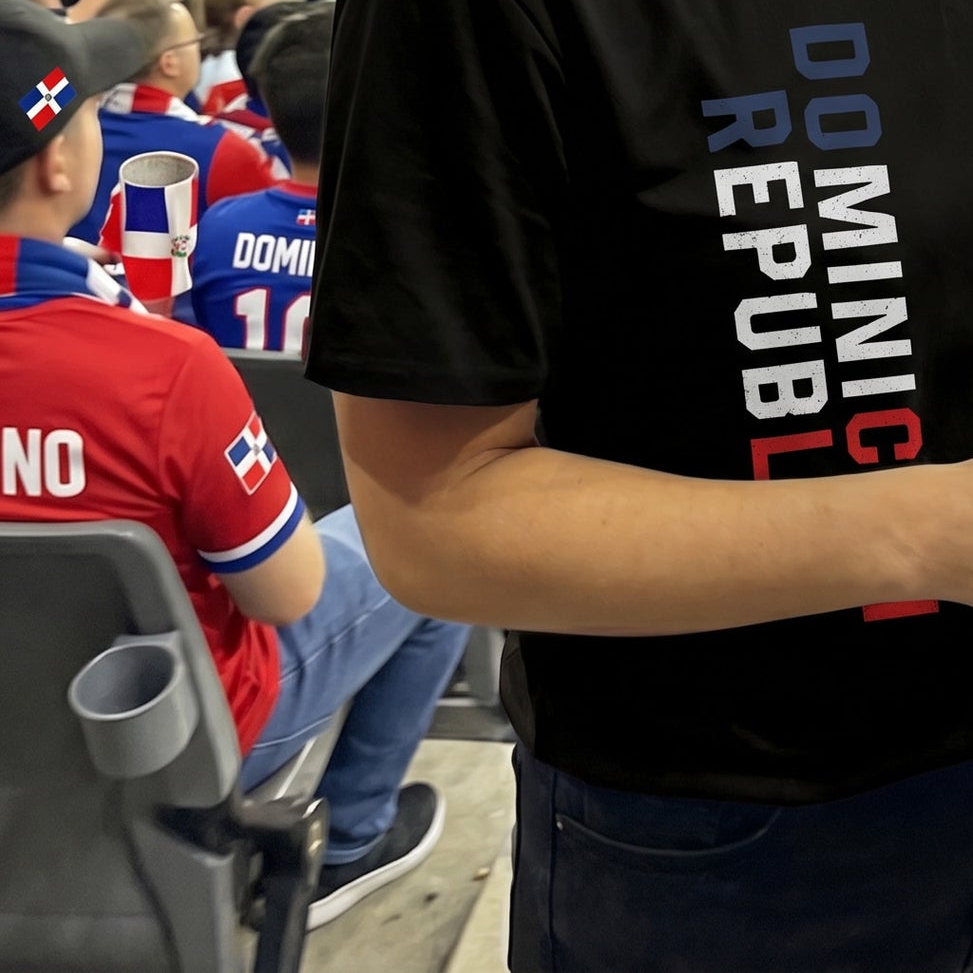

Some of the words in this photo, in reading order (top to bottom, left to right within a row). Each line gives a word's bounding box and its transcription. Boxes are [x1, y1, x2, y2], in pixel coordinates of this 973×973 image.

[2, 426, 87, 498] NO
[700, 89, 833, 481] REPUBL
[789, 21, 939, 623] DOMINIC
